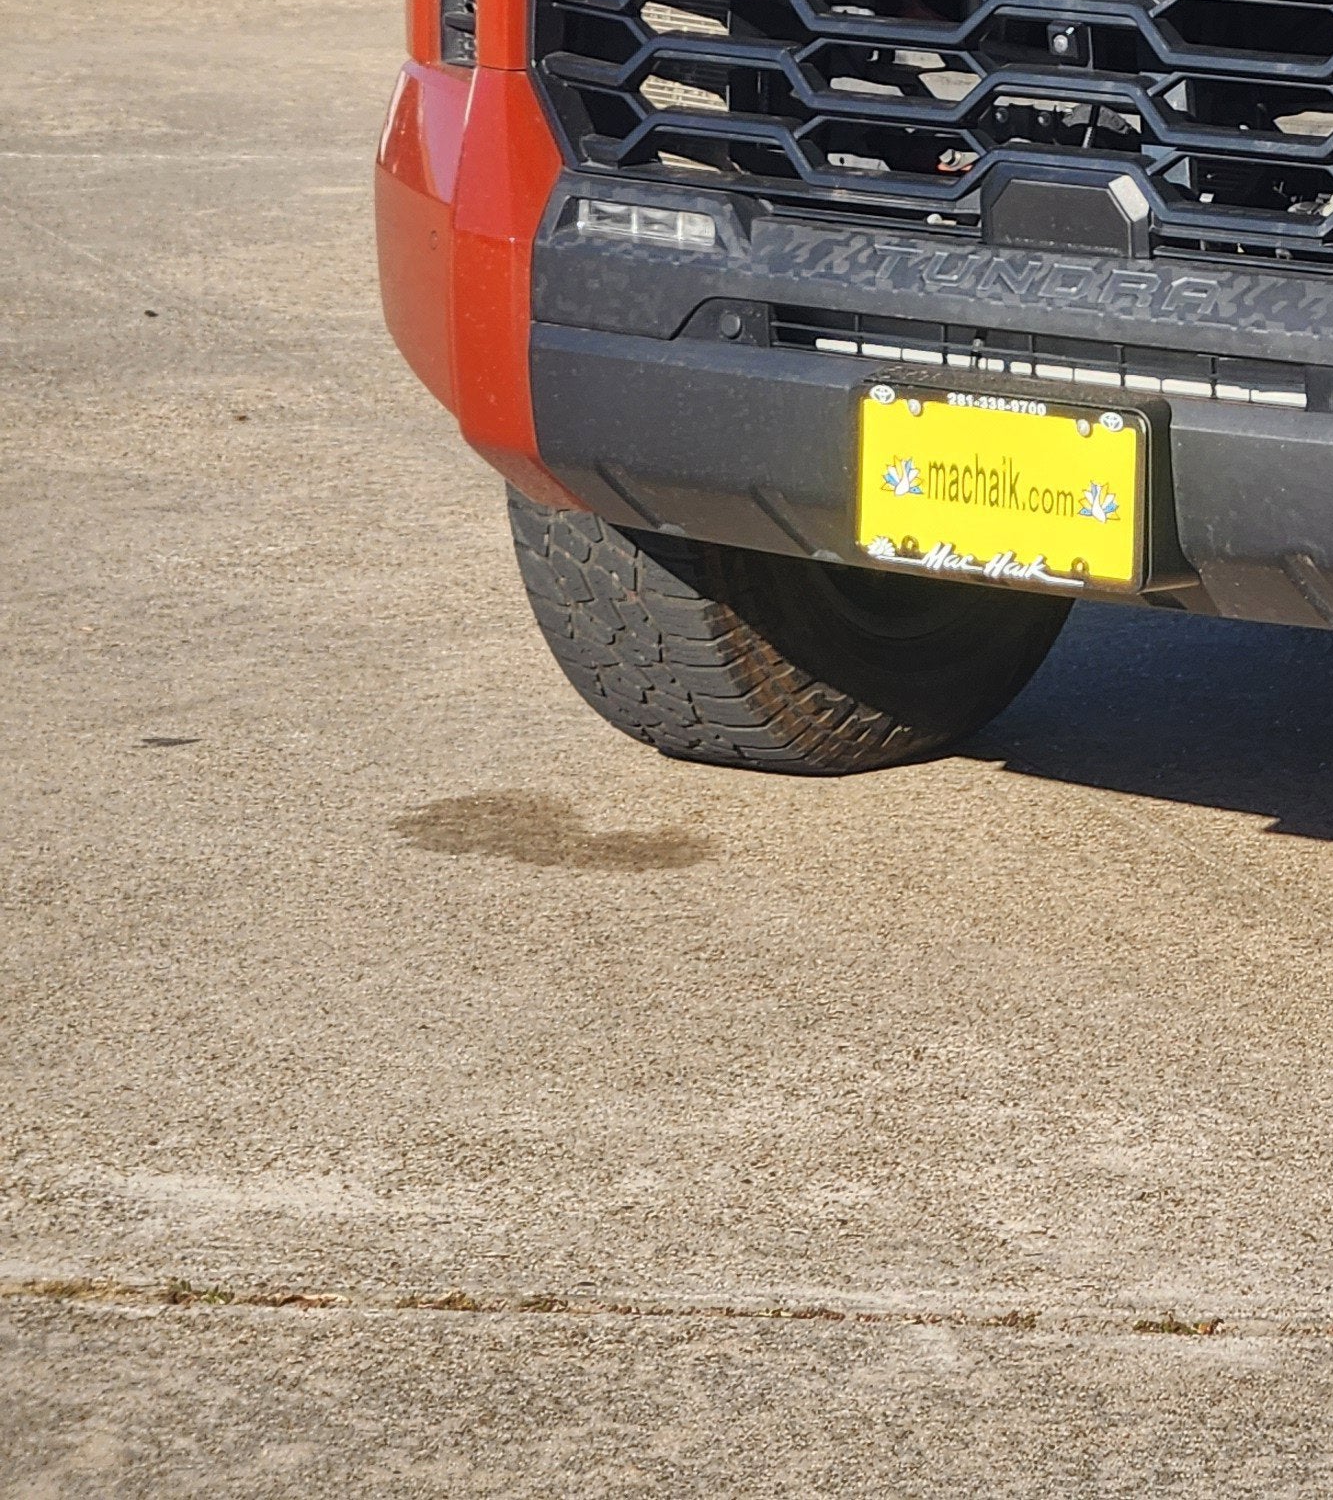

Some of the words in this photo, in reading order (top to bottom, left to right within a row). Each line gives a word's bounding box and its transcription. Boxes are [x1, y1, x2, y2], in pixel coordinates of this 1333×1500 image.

[874, 243, 1221, 314] TUNDRA
[947, 392, 1046, 416] 281-338-9700
[927, 453, 1076, 517] machaik.com
[921, 541, 983, 570] Mac
[982, 550, 1066, 583] Haik
